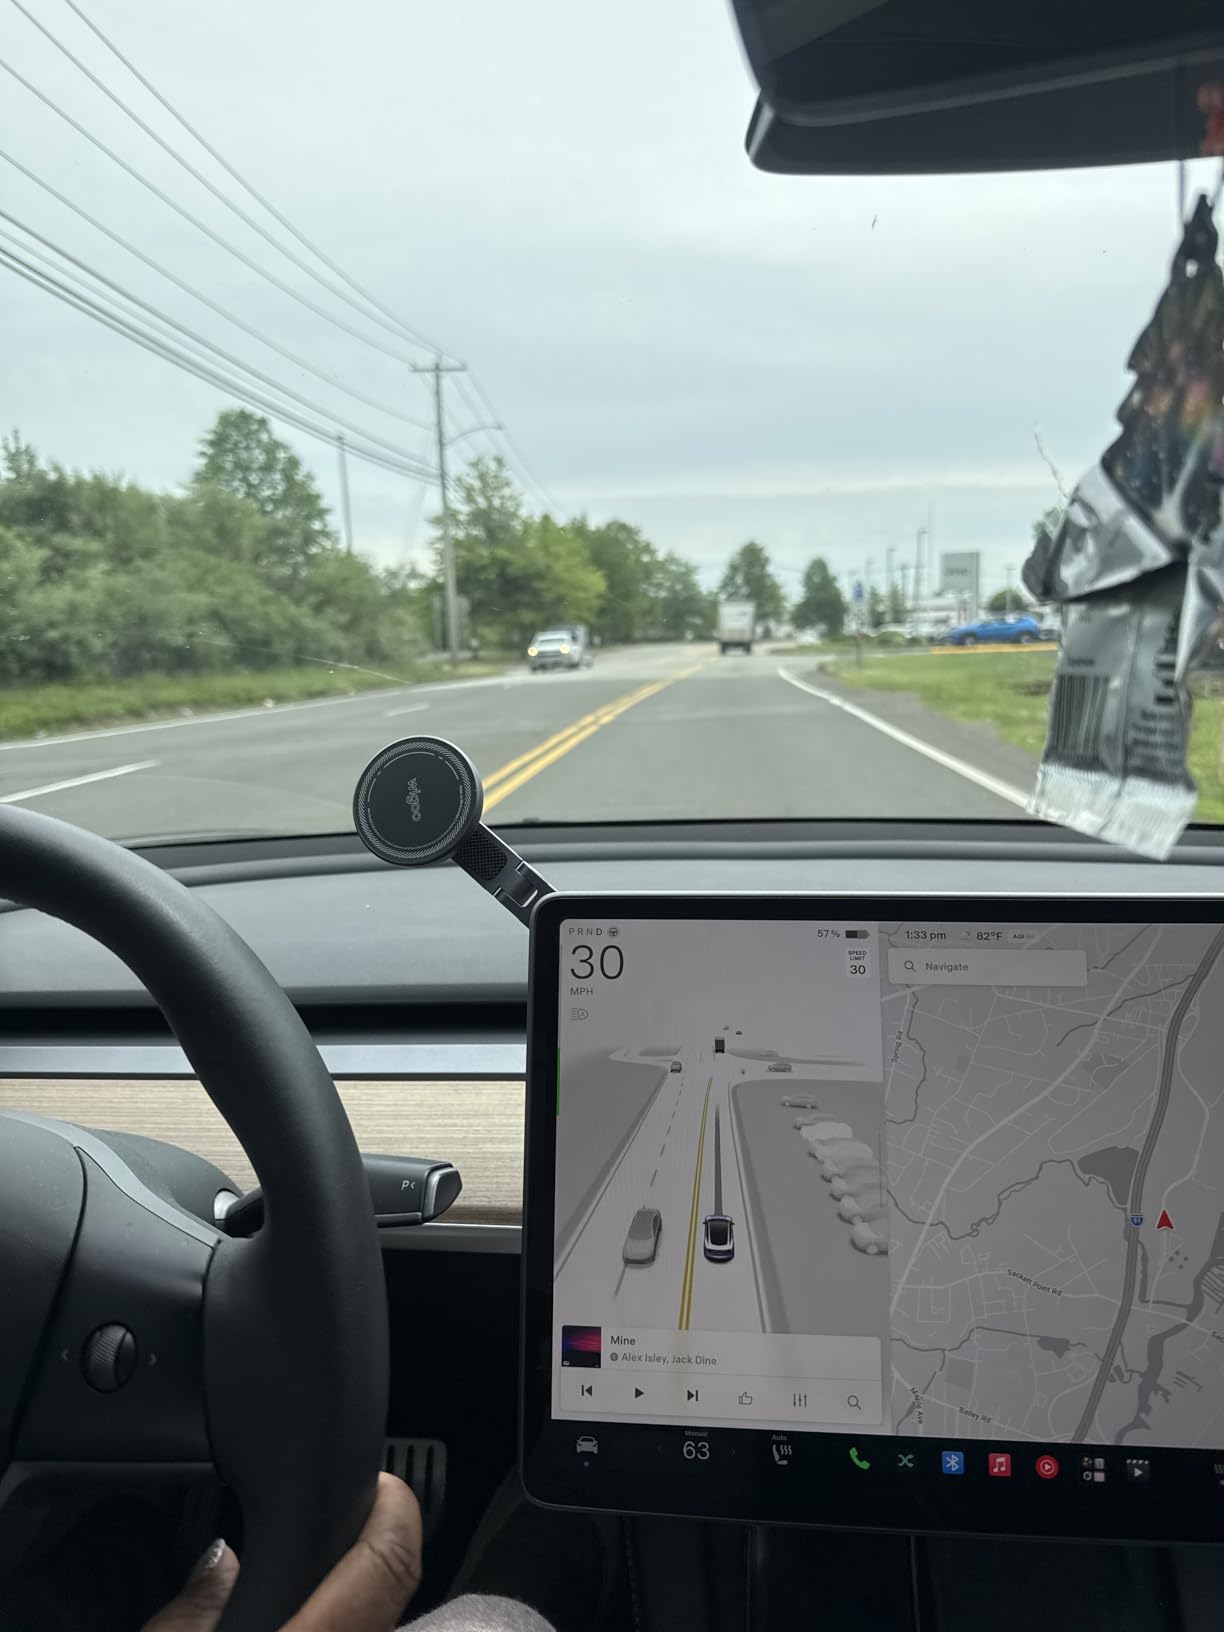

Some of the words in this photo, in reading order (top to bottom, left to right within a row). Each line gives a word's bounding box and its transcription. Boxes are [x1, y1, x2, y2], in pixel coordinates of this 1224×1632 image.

[406, 777, 421, 822] wigoo
[817, 929, 840, 938] 57%
[905, 930, 926, 940] 1:33
[928, 932, 947, 942] pm
[976, 931, 1003, 941] 82°F
[570, 944, 625, 980] 30
[925, 962, 969, 974] Navigate
[850, 964, 866, 975] 30
[570, 987, 594, 996] MPH
[1007, 1269, 1033, 1286] Sackett
[1032, 1281, 1051, 1293] Point
[1051, 1288, 1063, 1297] Rd
[610, 1335, 636, 1346] Mine
[621, 1352, 643, 1363] Alex
[645, 1353, 669, 1365] Isley,
[671, 1355, 693, 1365] Jack
[695, 1355, 717, 1366] Dine
[980, 1414, 992, 1424] Rd
[683, 1441, 710, 1460] 63
